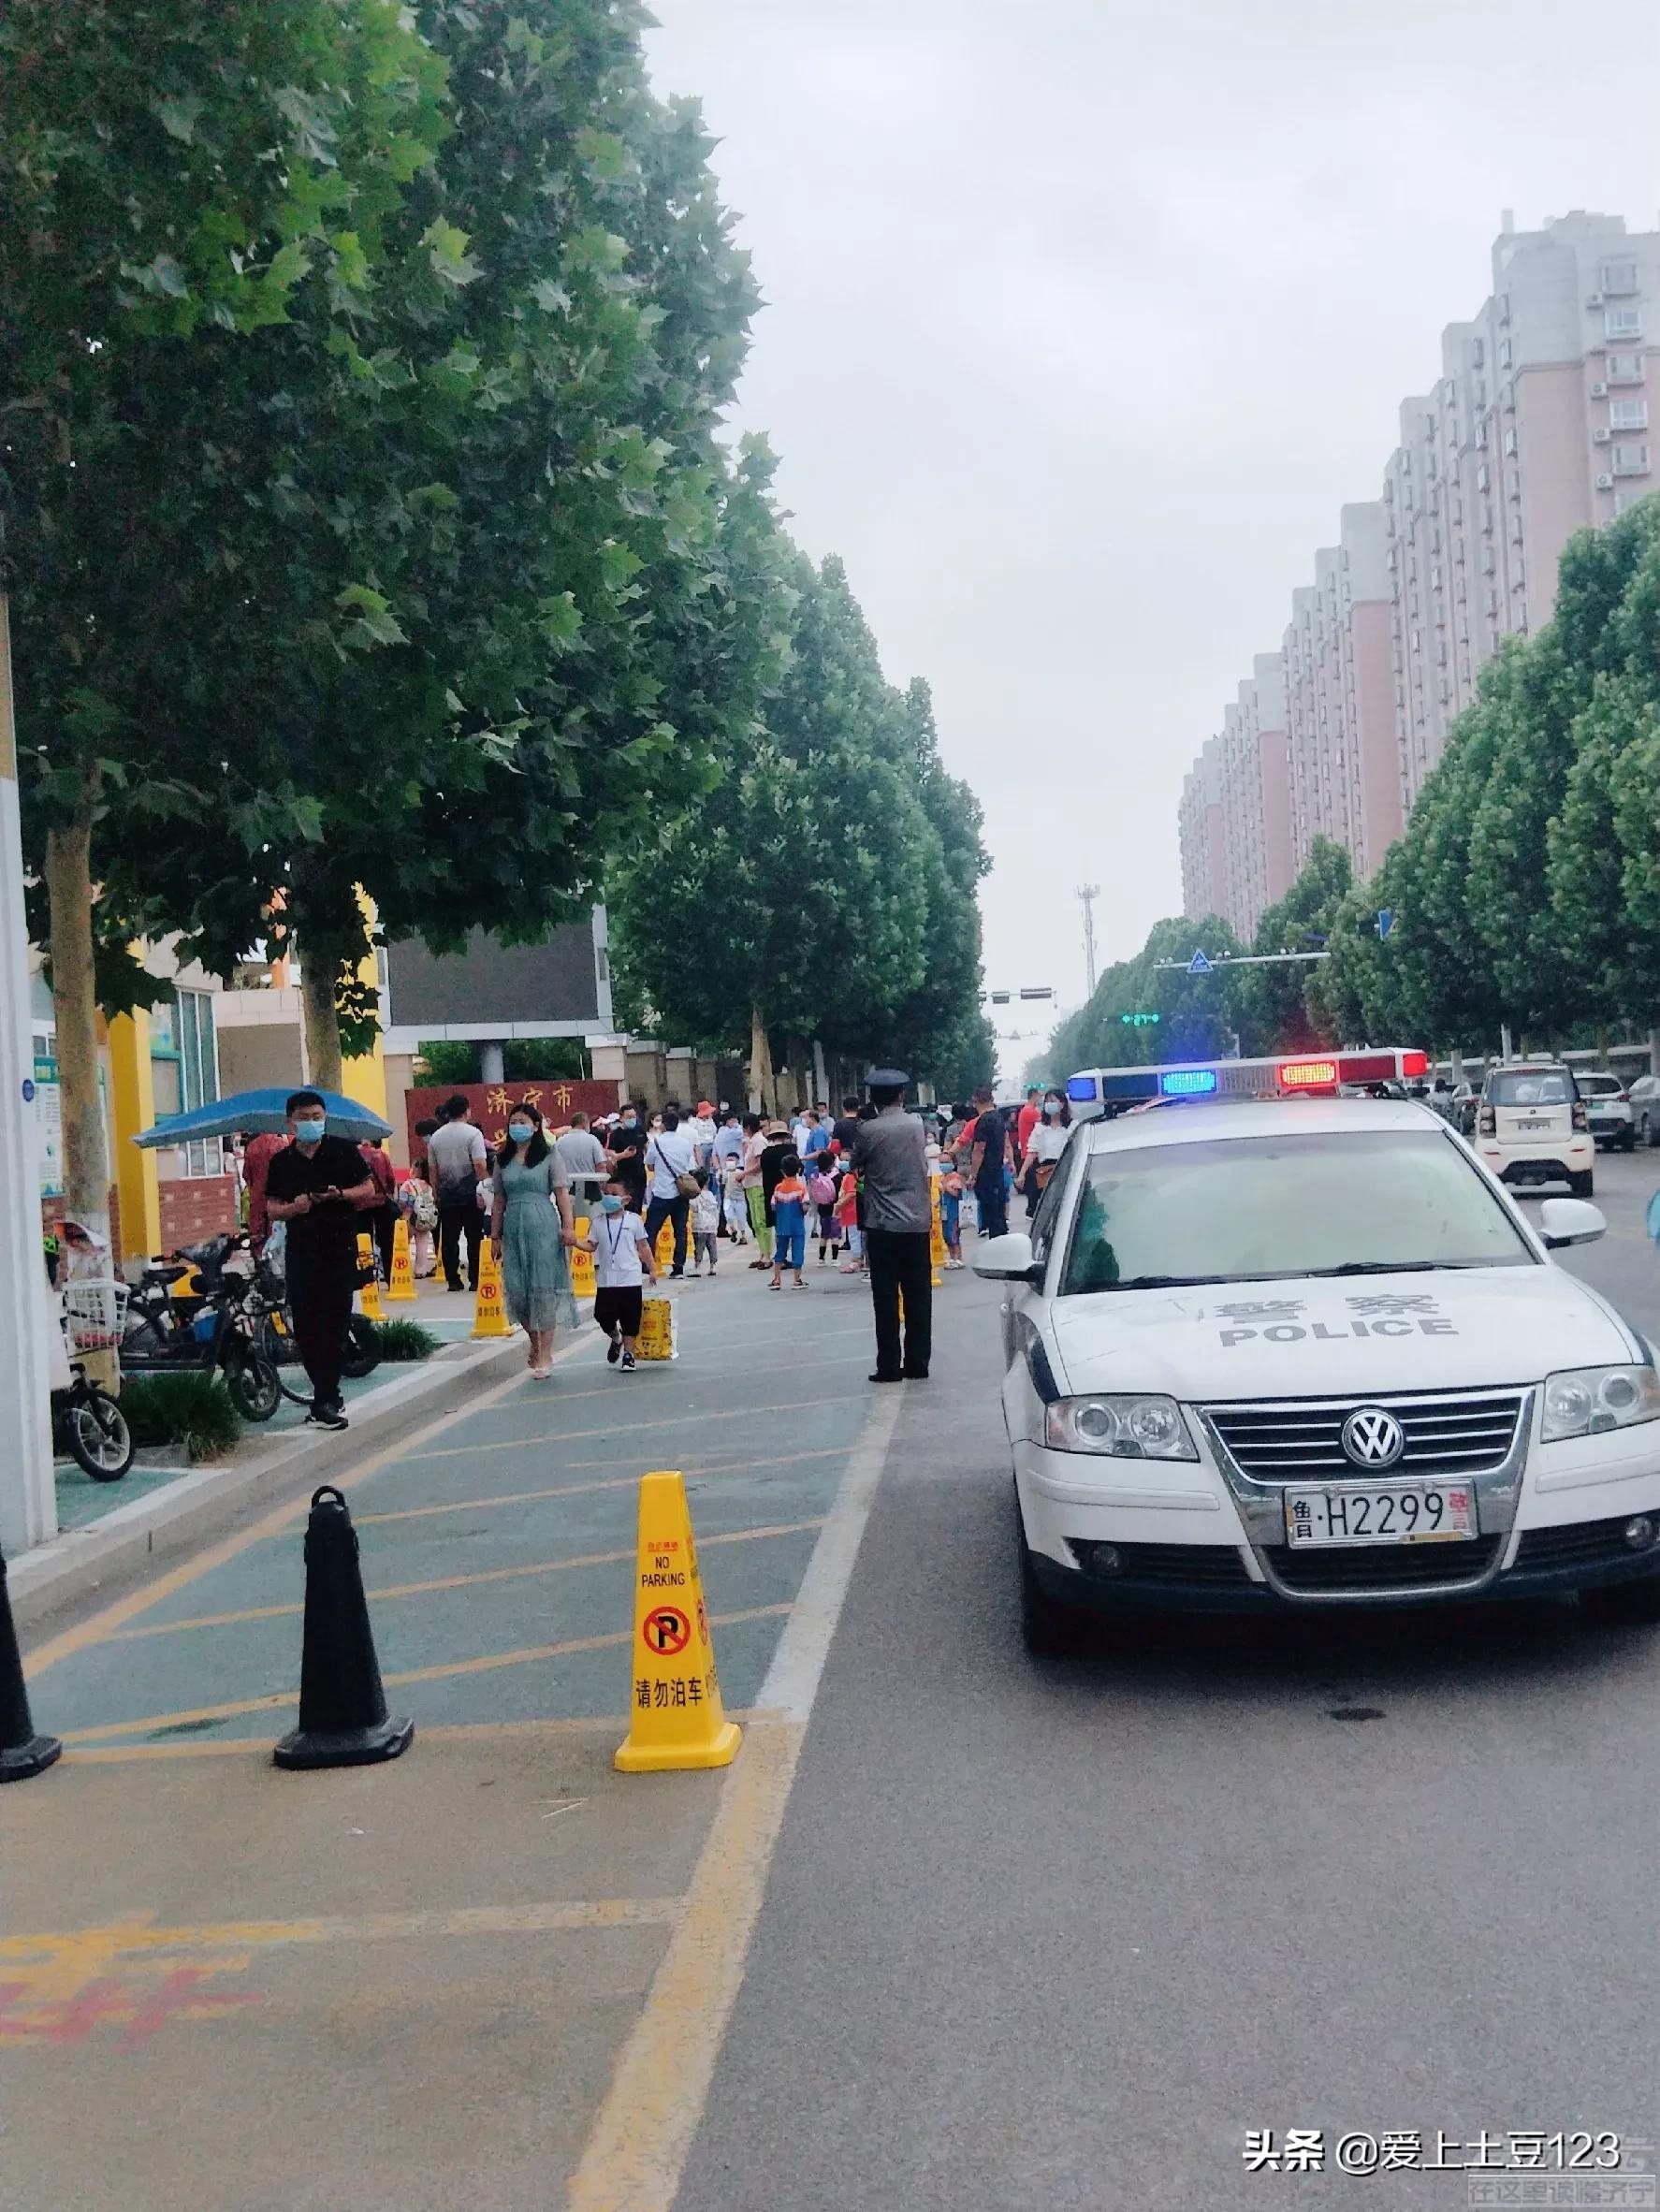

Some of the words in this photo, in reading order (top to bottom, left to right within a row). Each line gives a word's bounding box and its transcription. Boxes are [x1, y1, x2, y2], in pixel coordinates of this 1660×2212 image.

[487, 1084, 574, 1116] 济宁市
[1219, 1318, 1460, 1347] POLICE
[655, 1556, 670, 1569] NO
[642, 1572, 685, 1587] PARKING
[636, 1677, 702, 1708] 请勿泊车
